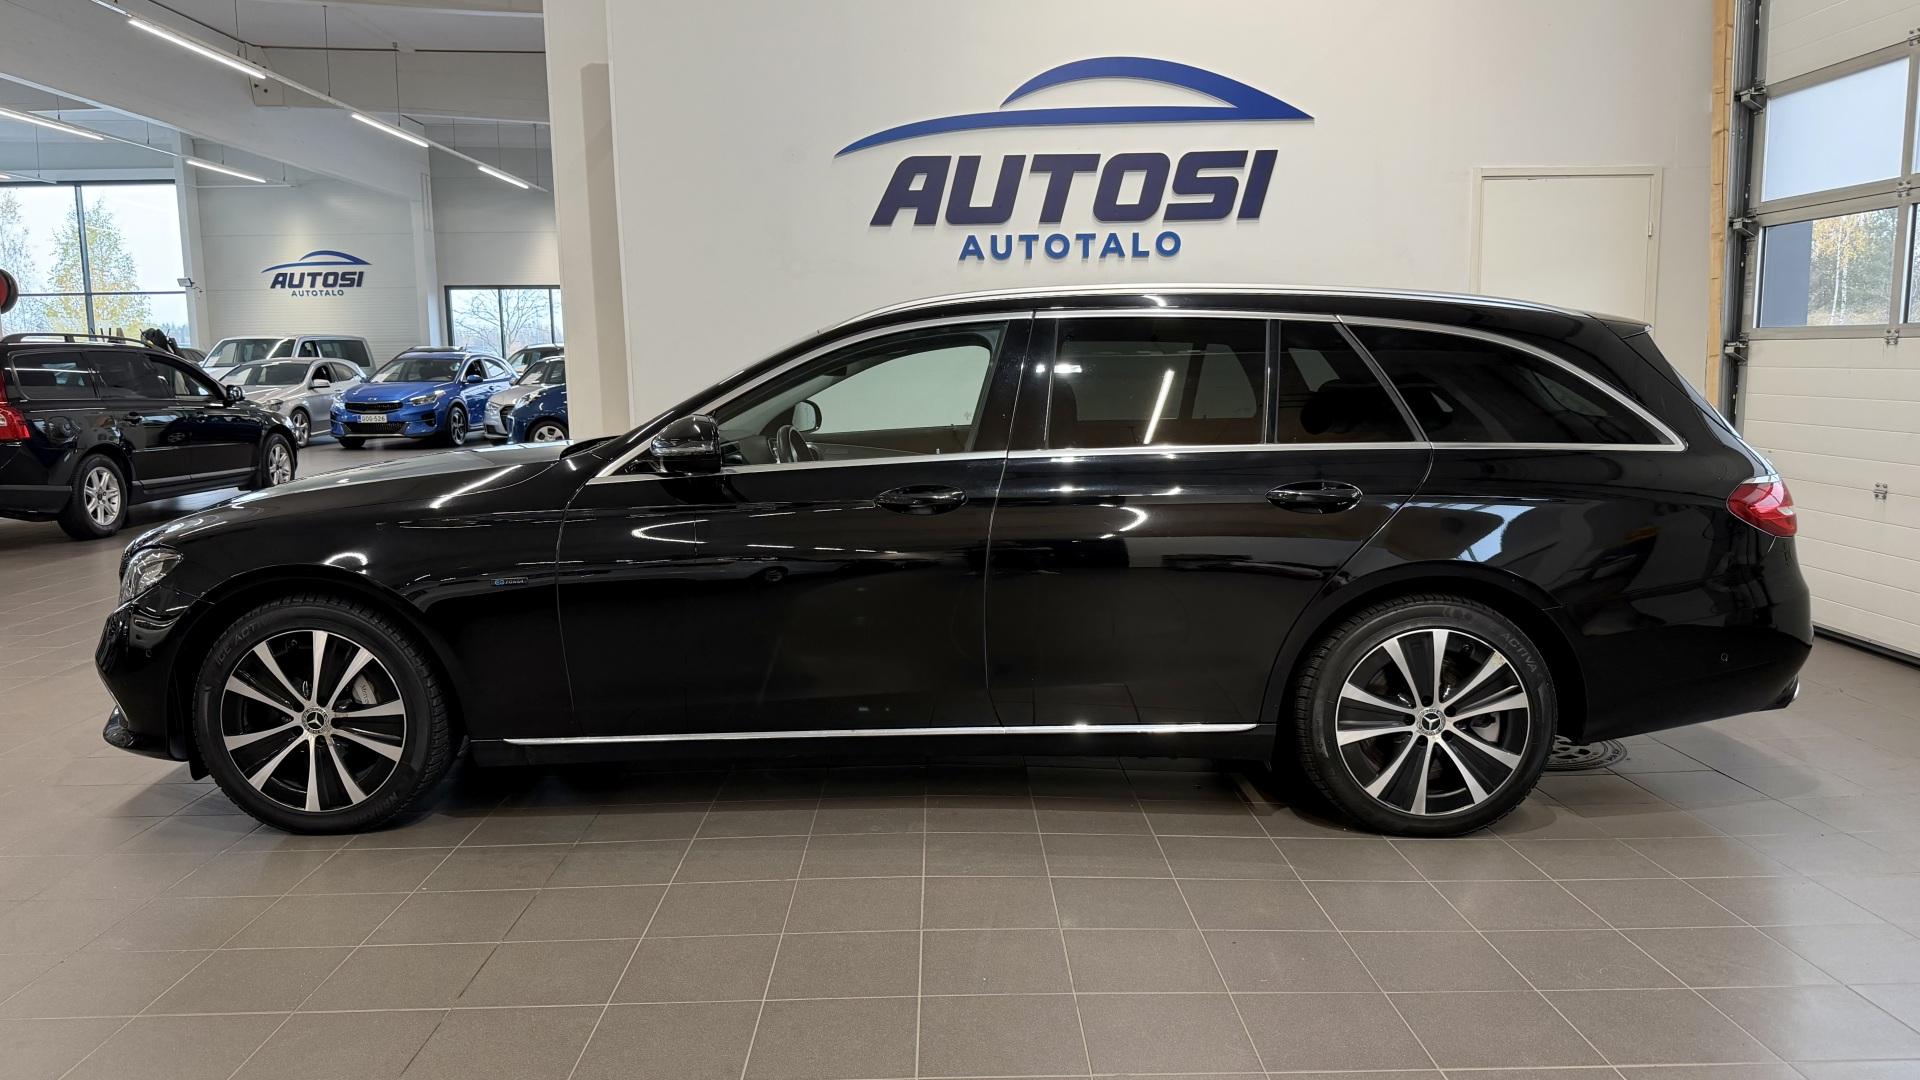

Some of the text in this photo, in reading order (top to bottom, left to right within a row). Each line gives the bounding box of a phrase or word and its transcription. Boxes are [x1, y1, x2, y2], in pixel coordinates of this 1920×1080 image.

[870, 149, 1278, 226] AUTOSI
[958, 231, 1182, 261] AUTOTALO
[270, 271, 365, 289] AUTOSI
[291, 289, 345, 297] AUTOTALO
